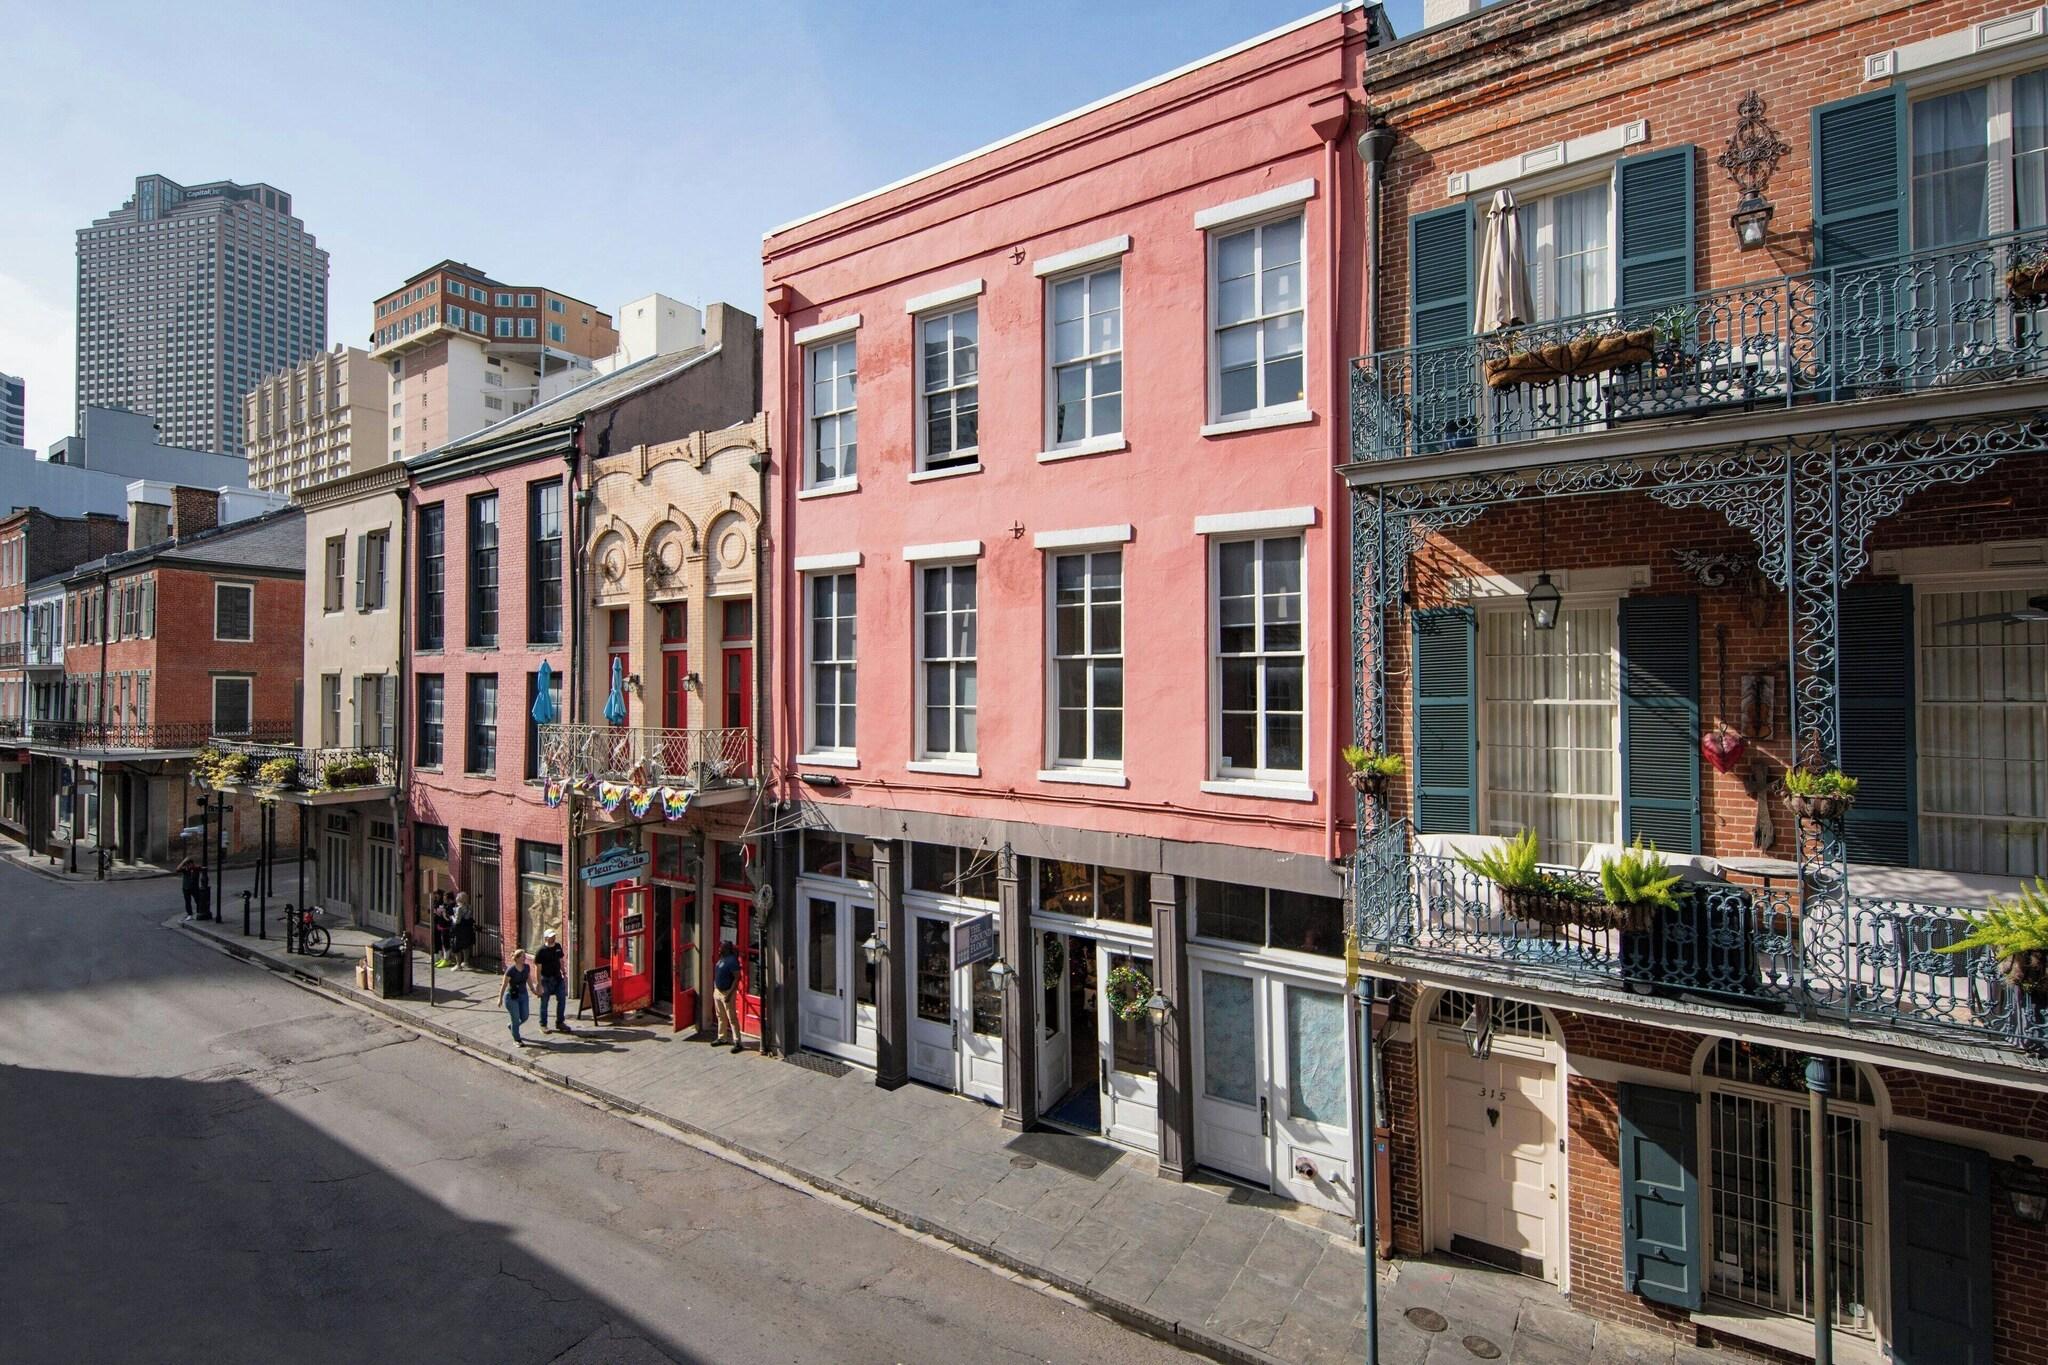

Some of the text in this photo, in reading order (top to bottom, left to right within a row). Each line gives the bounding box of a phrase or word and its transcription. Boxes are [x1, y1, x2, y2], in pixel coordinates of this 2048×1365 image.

[186, 188, 210, 198] Capital
[970, 924, 981, 935] THE
[970, 928, 992, 943] GROUND
[970, 940, 988, 954] FLOOR
[1478, 1088, 1506, 1101] 315
